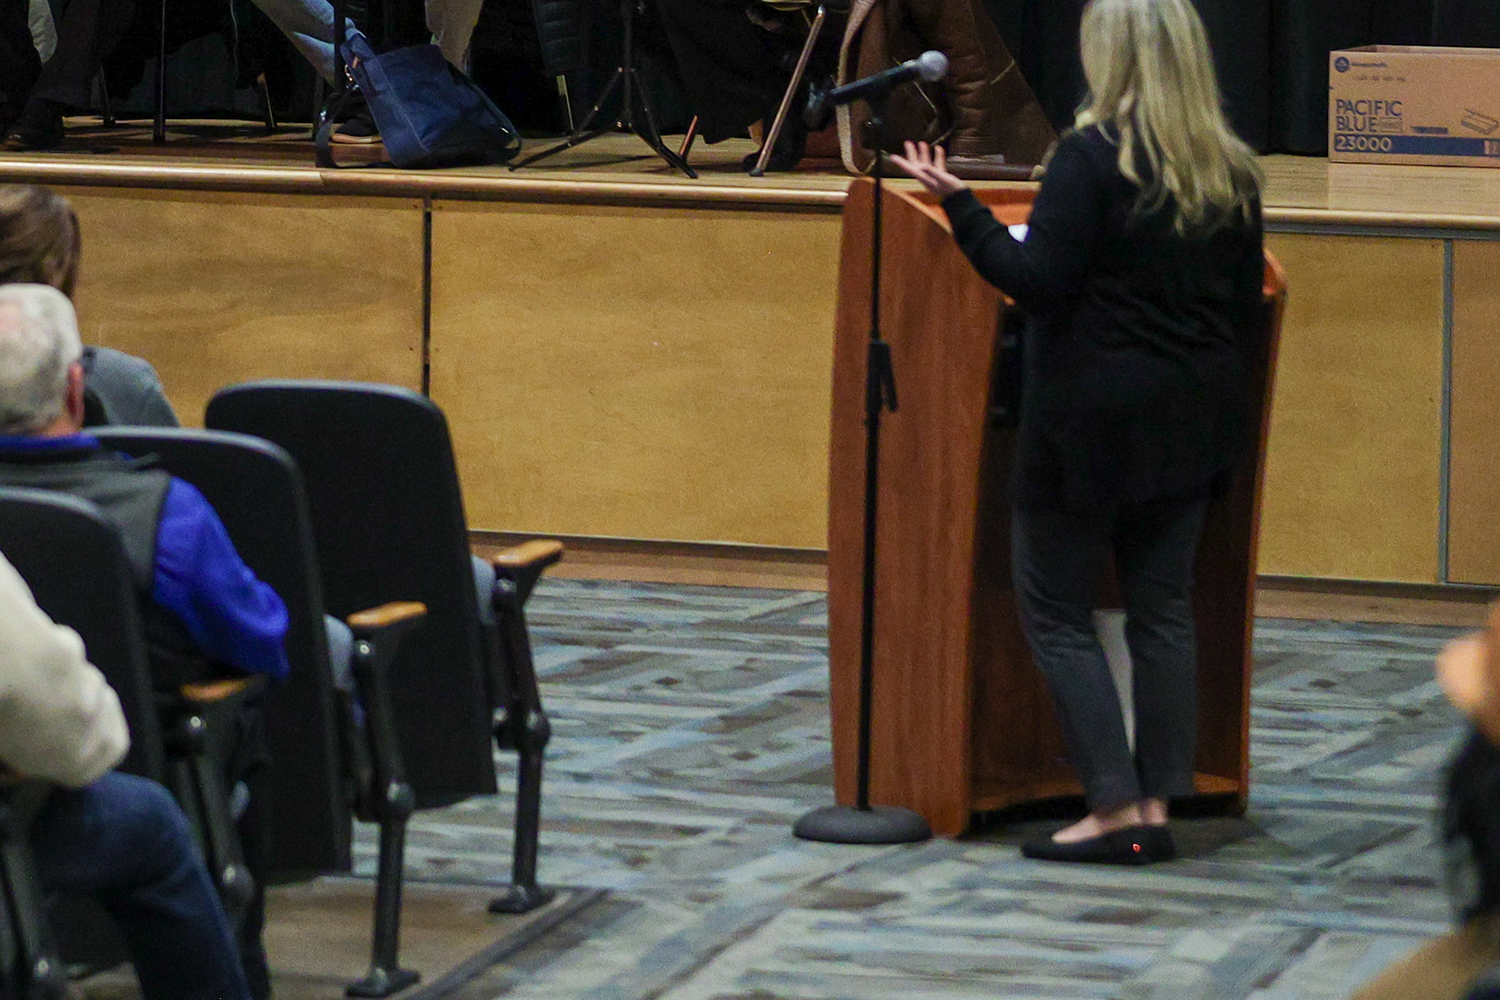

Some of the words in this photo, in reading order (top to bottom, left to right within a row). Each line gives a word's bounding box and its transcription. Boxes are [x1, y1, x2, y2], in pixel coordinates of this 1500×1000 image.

[1335, 99, 1403, 117] PACIFIC
[1335, 115, 1377, 133] BLUE
[1336, 136, 1392, 151] 23000
